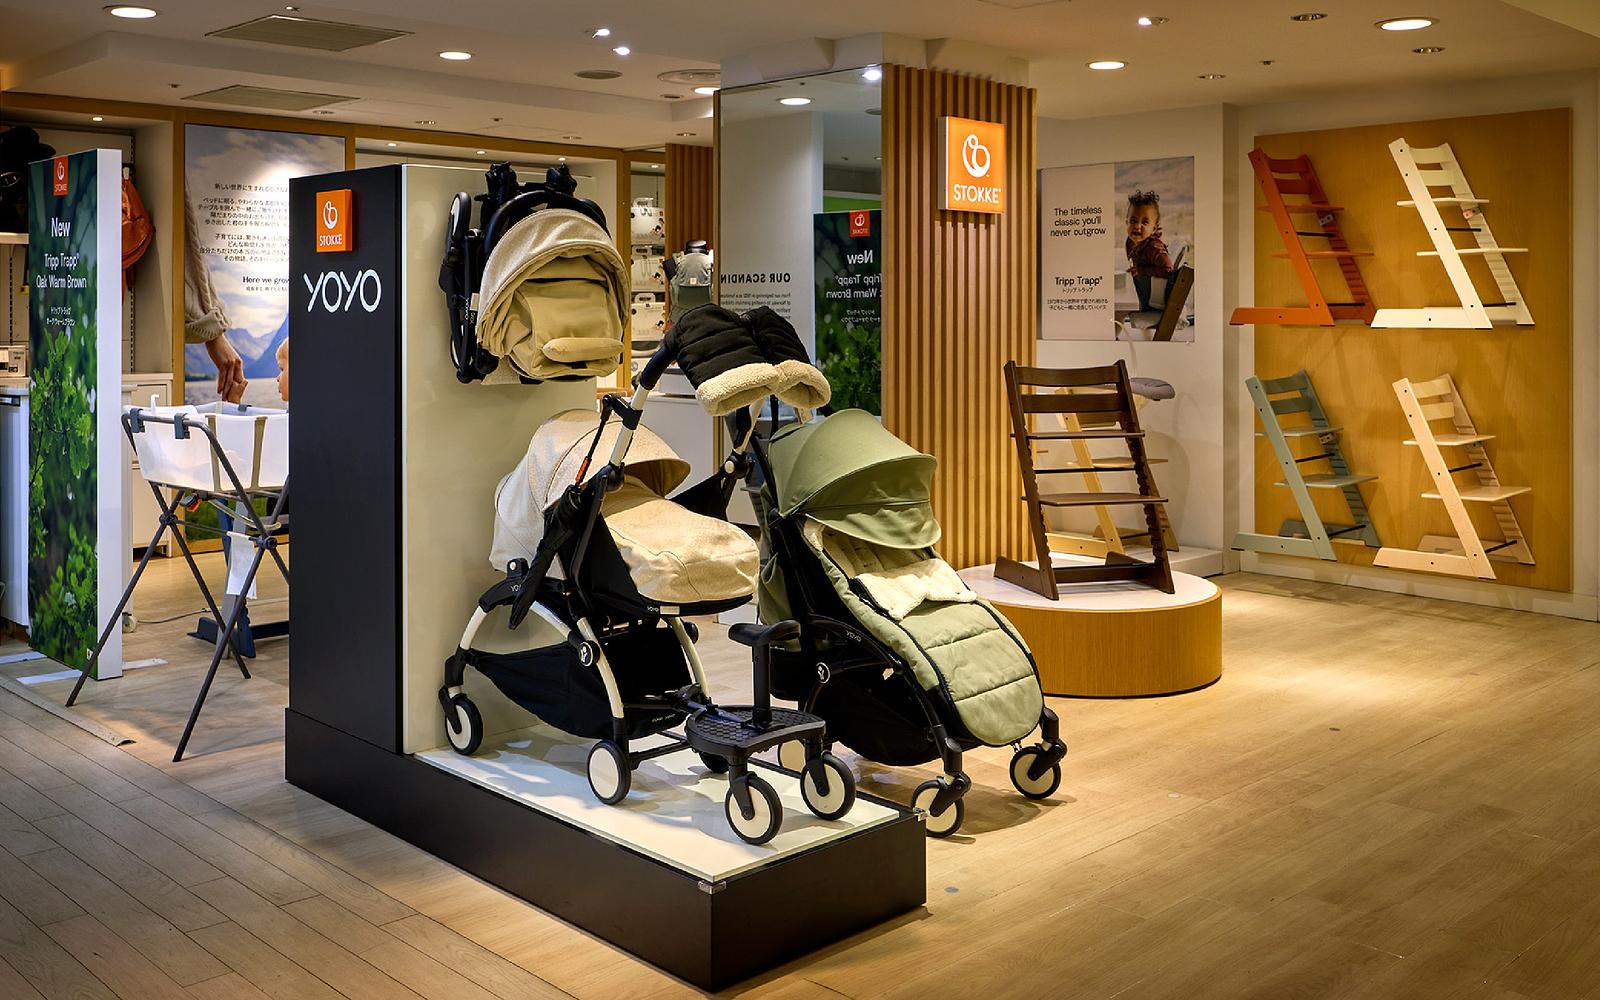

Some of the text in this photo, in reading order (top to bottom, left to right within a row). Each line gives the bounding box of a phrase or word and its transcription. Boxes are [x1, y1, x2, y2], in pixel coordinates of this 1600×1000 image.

[1054, 206, 1102, 216] The timeless
[51, 217, 71, 237] New
[1054, 215, 1101, 227] classic you'll
[1074, 227, 1106, 237] outgrow
[319, 234, 342, 246] STOKKE
[44, 254, 59, 270] Tripp
[36, 275, 87, 288] Oak Warm Brown
[1055, 276, 1074, 286] Tripp
[303, 269, 382, 313] YOYO
